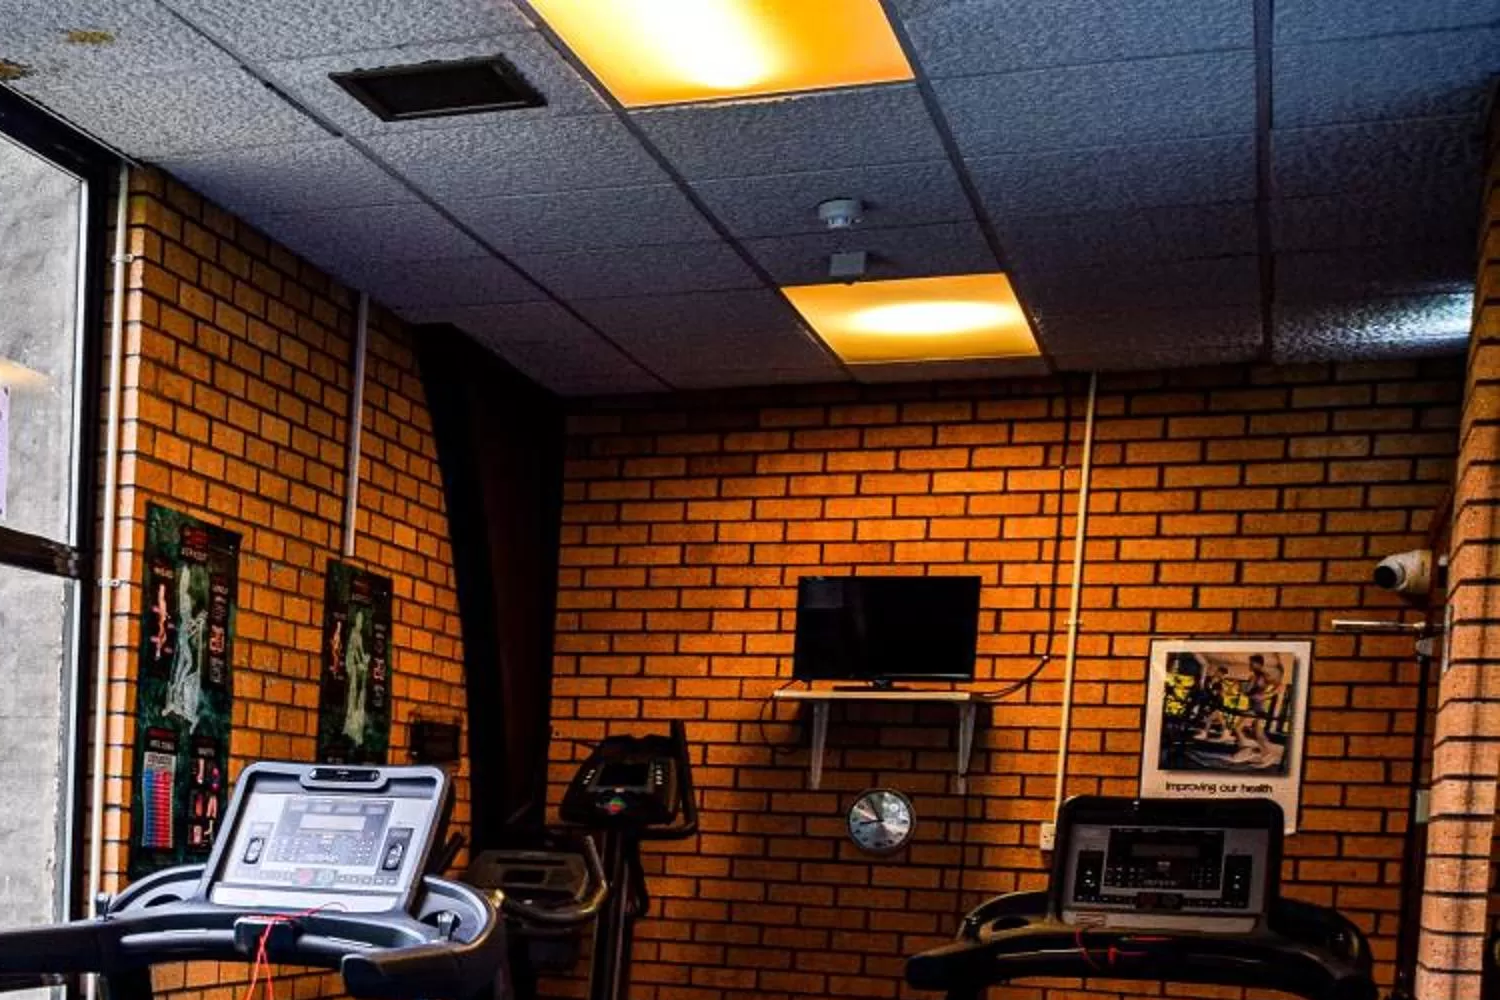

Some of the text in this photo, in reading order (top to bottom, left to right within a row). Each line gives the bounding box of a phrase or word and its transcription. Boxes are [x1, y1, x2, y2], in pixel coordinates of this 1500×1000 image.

[1165, 781, 1273, 794] Improving our health
